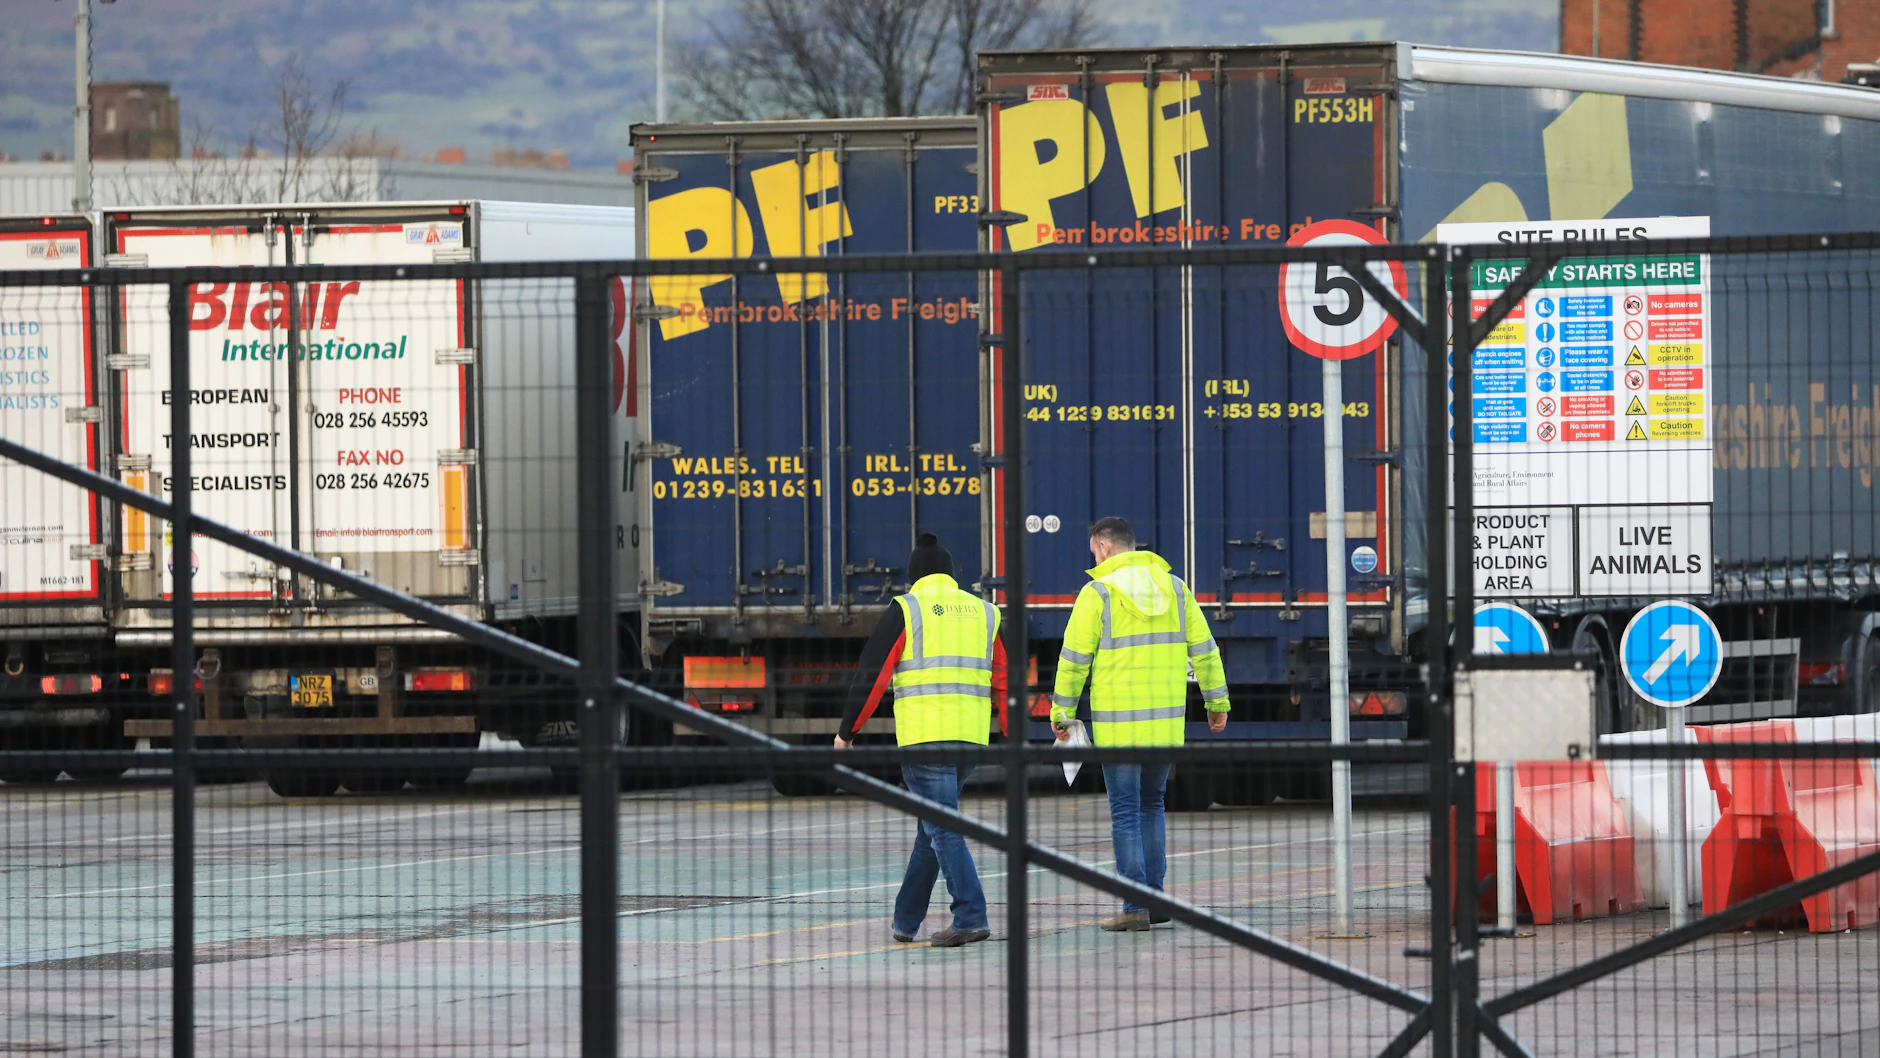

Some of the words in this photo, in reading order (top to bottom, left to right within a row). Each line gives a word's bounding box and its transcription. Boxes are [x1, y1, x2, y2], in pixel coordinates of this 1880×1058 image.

[1295, 97, 1373, 123] PF553H
[1000, 79, 1209, 252] PF
[1497, 229, 1552, 244] SITE
[1562, 226, 1648, 243] RULES
[648, 150, 853, 340] PF
[1485, 264, 1557, 284] SAFY
[1563, 262, 1637, 281] STARTS
[1642, 261, 1695, 279] HERE
[186, 266, 361, 331] Blair
[1313, 261, 1364, 327] 5
[680, 299, 881, 323] Pembrokeshire
[1651, 301, 1663, 309] No
[0, 347, 48, 360] OZEN
[1476, 350, 1497, 358] Switch
[1497, 350, 1522, 358] engines
[1501, 358, 1524, 366] waiting
[1580, 356, 1608, 364] covering
[1657, 353, 1694, 363] operation
[162, 389, 268, 405] EROPEAN
[339, 387, 401, 404] PHONE
[1024, 385, 1057, 402] UK)
[1023, 407, 1051, 421] 44
[1057, 406, 1103, 421] 1239
[1107, 404, 1175, 420] 831631
[1257, 402, 1282, 418] 53
[1662, 406, 1690, 414] operating
[314, 413, 344, 429] 028
[349, 412, 377, 428] 256
[381, 411, 428, 427] 45593
[1660, 421, 1693, 430] Caution
[163, 432, 280, 449] TANSPORT
[1575, 431, 1601, 439] phones
[337, 450, 370, 466] FAX
[376, 449, 404, 465] NO
[672, 457, 757, 475] WALES.
[866, 454, 910, 472] IRL.
[919, 453, 967, 471] TEL.
[163, 475, 286, 492] SECIALISTS
[316, 474, 346, 490] 028
[350, 473, 378, 489] 256
[383, 472, 429, 488] 42675
[653, 479, 822, 499] 01239-831631
[851, 477, 981, 496] 053-43678
[1506, 479, 1527, 487] Affairs
[1028, 518, 1040, 530] 80
[1046, 518, 1058, 530] 90
[1488, 535, 1545, 549] PLANT
[1619, 526, 1672, 546] LIVE
[1590, 554, 1702, 575] ANIMALS
[1485, 576, 1533, 590] AREA
[946, 604, 978, 614] DAERA
[300, 676, 326, 689] NRZ
[360, 676, 375, 686] GB
[293, 691, 330, 704] 3075
